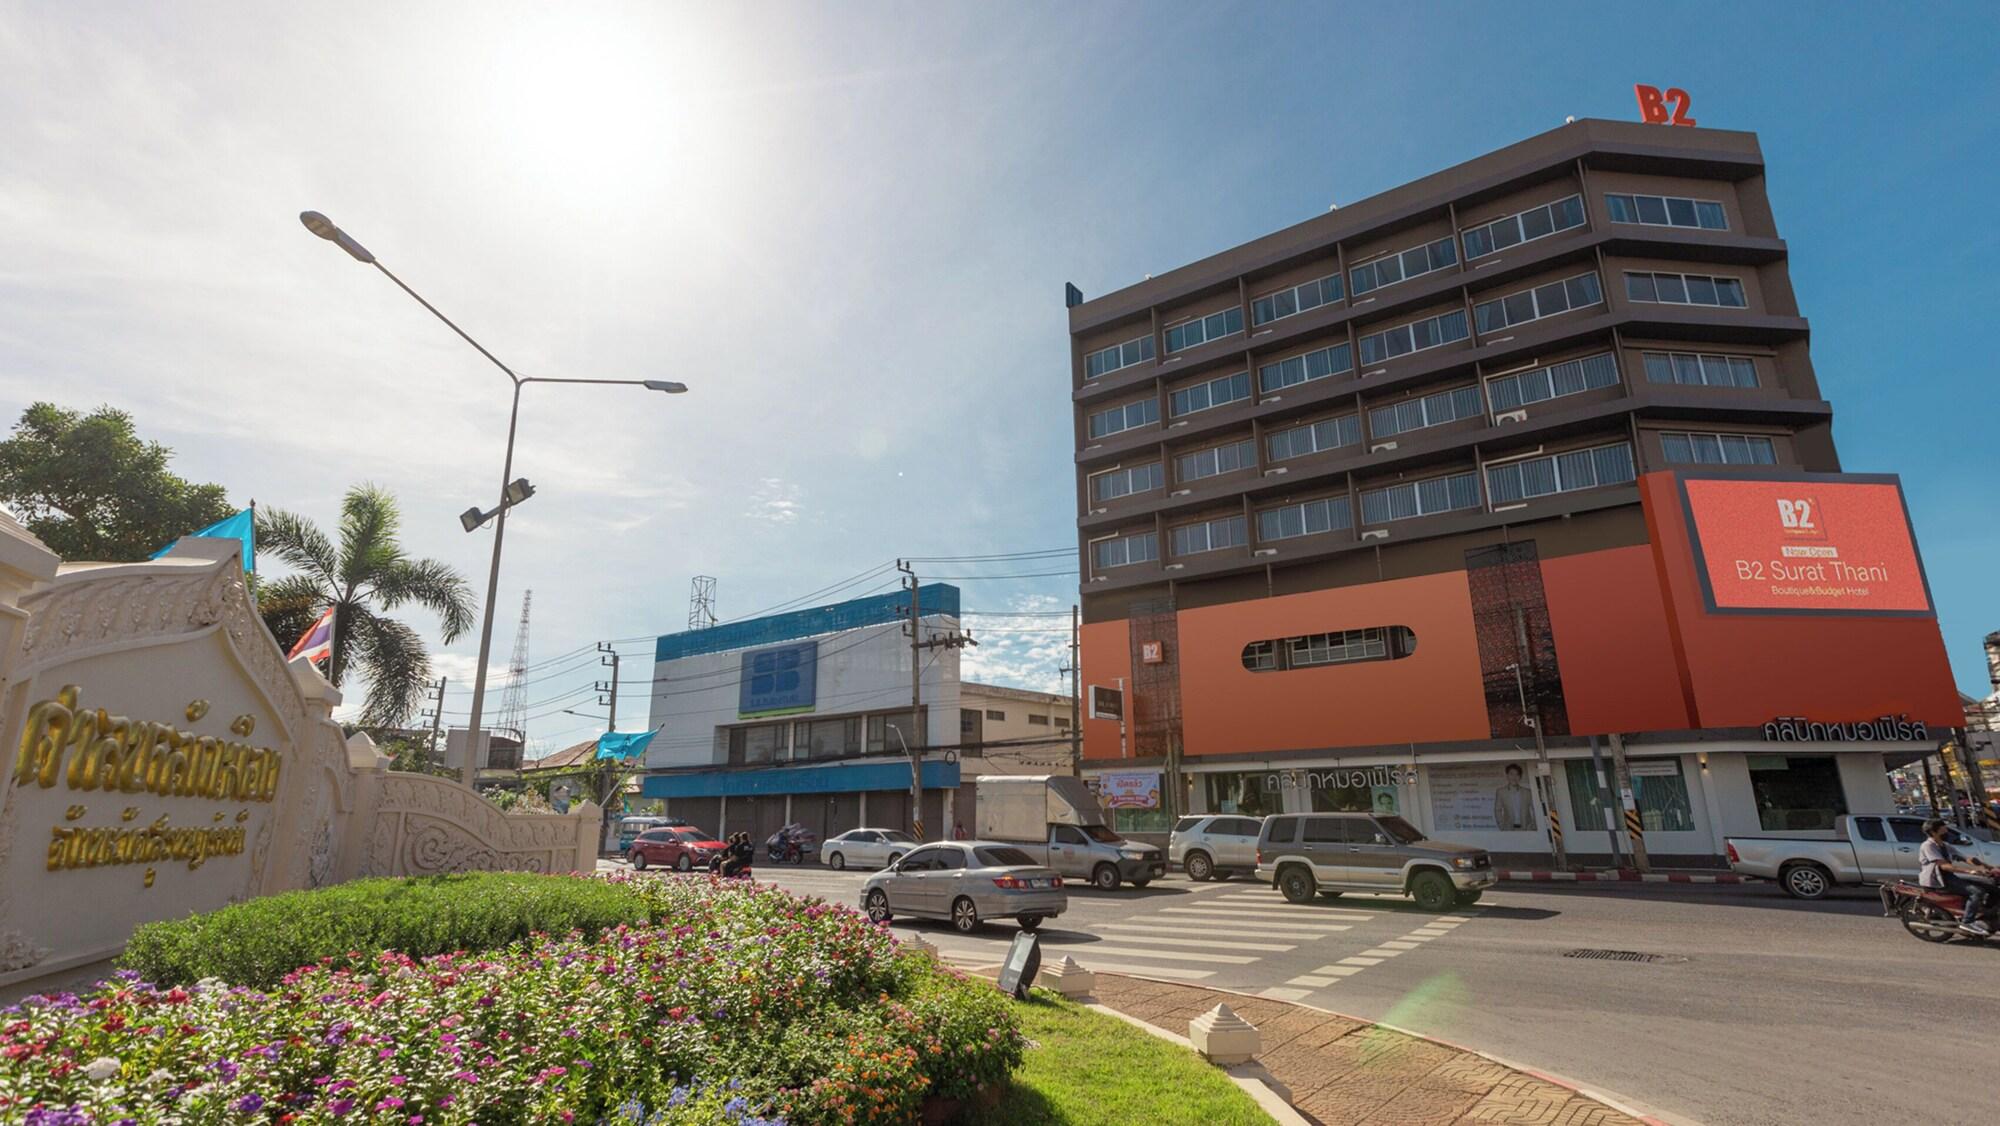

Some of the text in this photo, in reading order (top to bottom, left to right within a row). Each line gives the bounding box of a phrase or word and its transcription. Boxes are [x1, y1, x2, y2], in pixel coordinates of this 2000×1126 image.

[1634, 84, 1696, 127] B2
[1777, 499, 1815, 528] B2
[1735, 560, 1888, 583] B2 Surat Thani
[1771, 586, 1869, 598] Boutique&Budget Hotel
